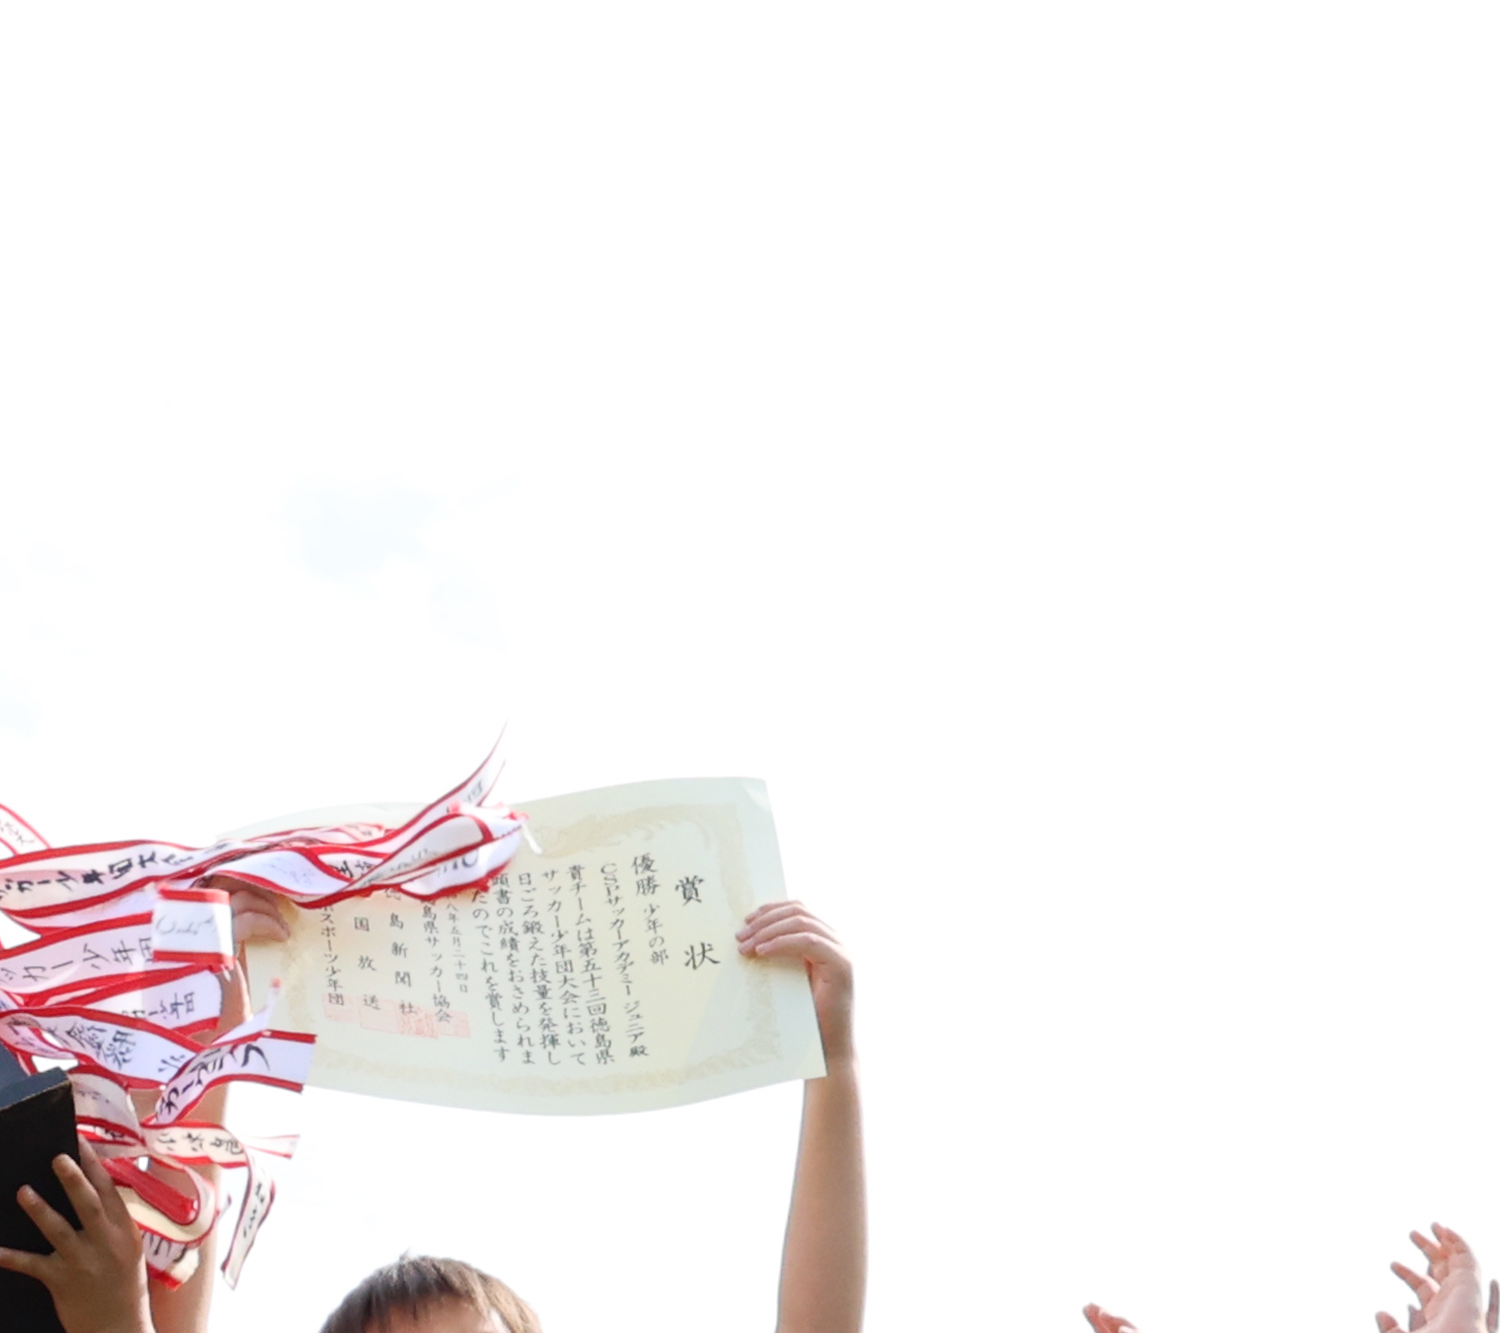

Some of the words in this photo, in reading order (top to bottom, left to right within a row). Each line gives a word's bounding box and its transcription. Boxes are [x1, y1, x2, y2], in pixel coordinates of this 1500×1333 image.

[631, 853, 661, 896] 優勝
[644, 903, 669, 965] 少年の部
[675, 875, 722, 970] 賞状
[517, 872, 562, 1066] 日ごろ鍛えた技量を発揮し
[542, 869, 587, 1066] サッカー少年団大会において
[568, 864, 616, 1066] 貴チームは第五十三回徳島県
